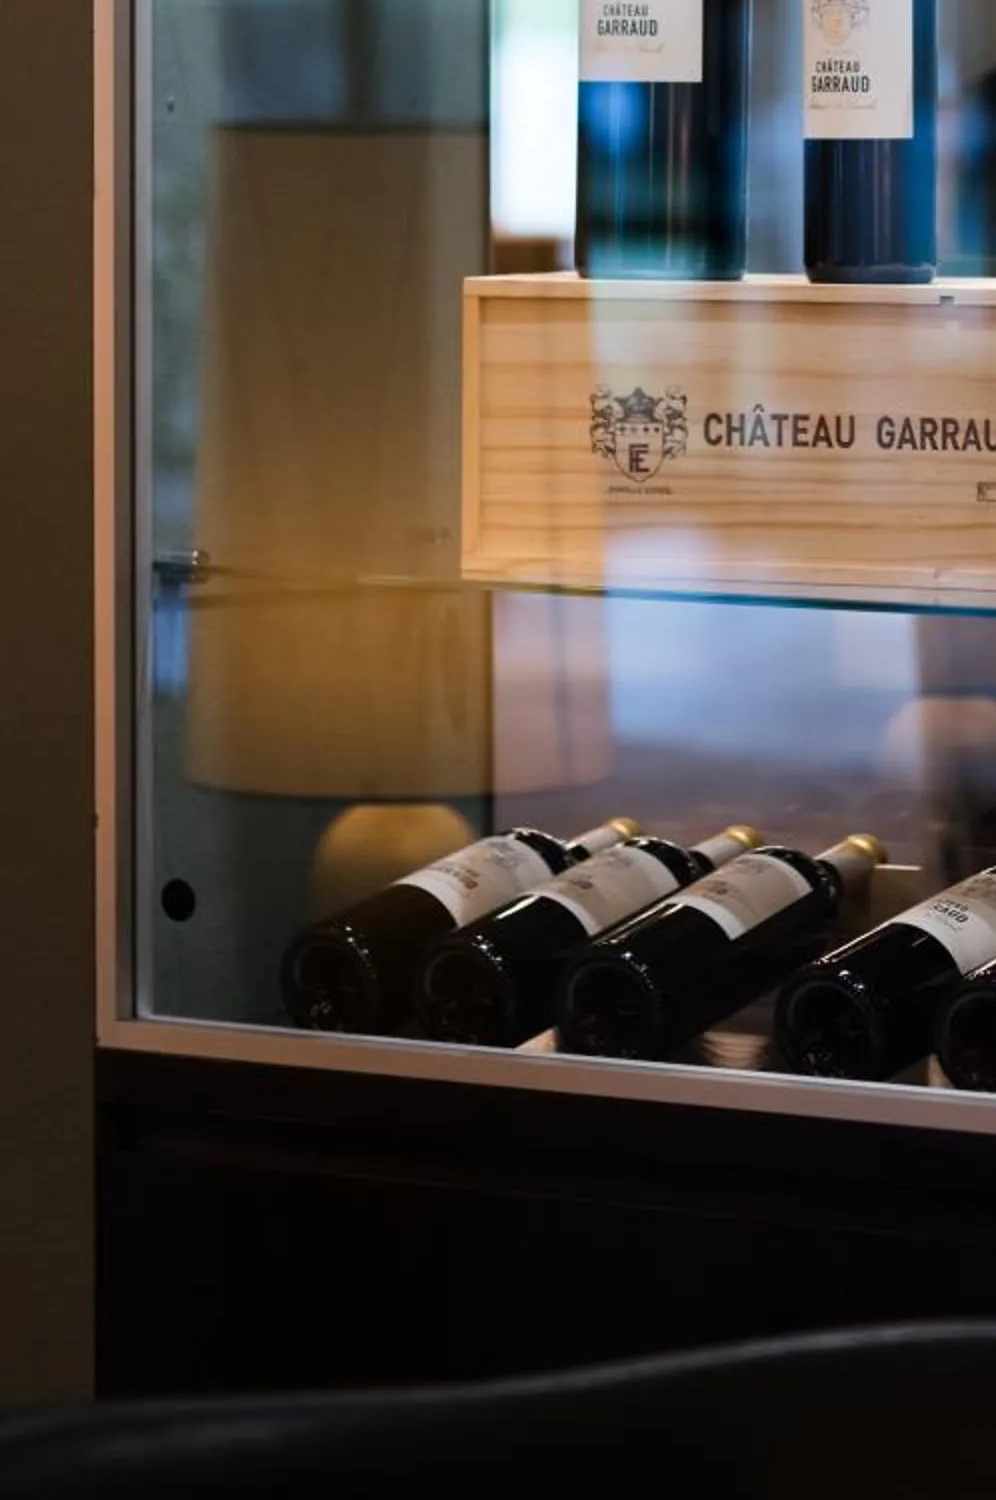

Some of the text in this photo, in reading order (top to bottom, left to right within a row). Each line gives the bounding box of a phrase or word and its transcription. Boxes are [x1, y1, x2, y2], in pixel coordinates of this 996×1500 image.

[597, 19, 659, 37] GARRAUD
[811, 76, 871, 93] GARRAUD
[703, 404, 855, 448] CHÂTEAU
